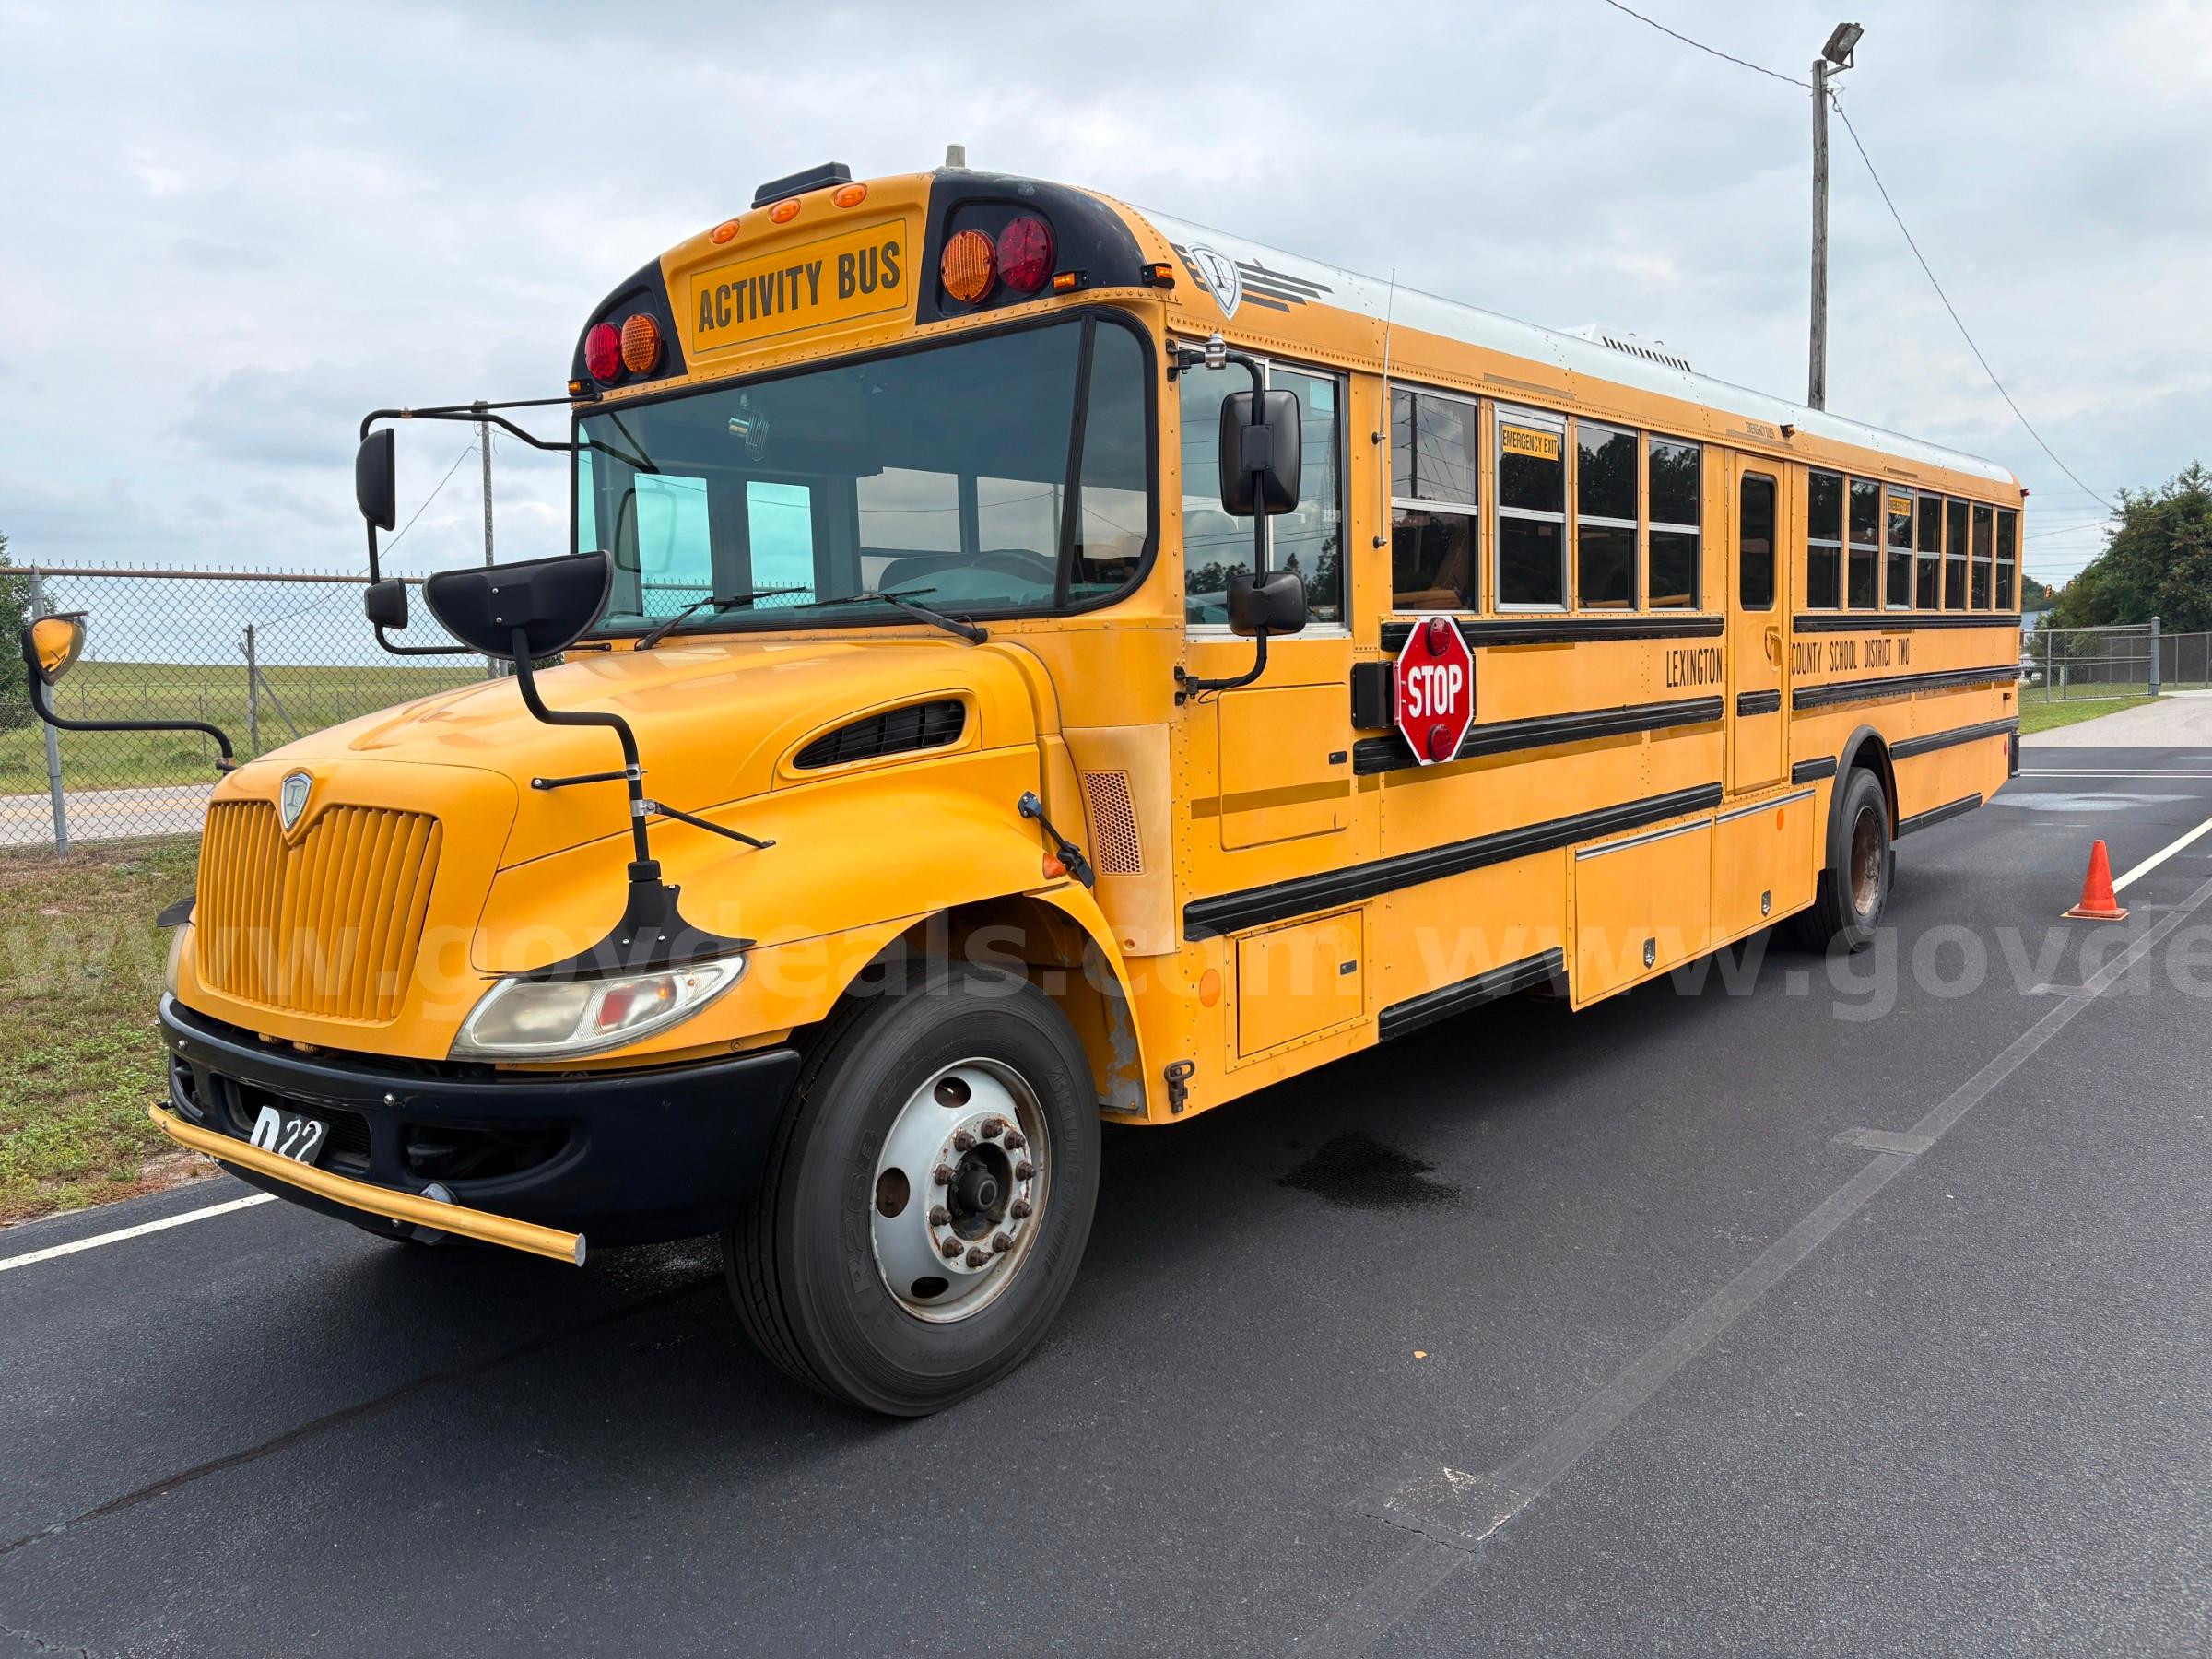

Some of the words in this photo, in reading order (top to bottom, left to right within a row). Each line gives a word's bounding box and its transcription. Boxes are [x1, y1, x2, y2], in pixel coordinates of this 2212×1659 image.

[698, 259, 823, 333] ACTIVITY
[838, 241, 900, 300] BUS
[1502, 429, 1543, 452] EMERGENCY
[1543, 438, 1558, 455] EXIT
[1666, 647, 1724, 688] LEXINGTON
[1791, 642, 1822, 676] COUNTY
[1830, 639, 1858, 672] SCHOOL
[1864, 638, 1893, 668] DISTRICT
[1897, 637, 1910, 666] TWO
[1407, 664, 1463, 718] STOP
